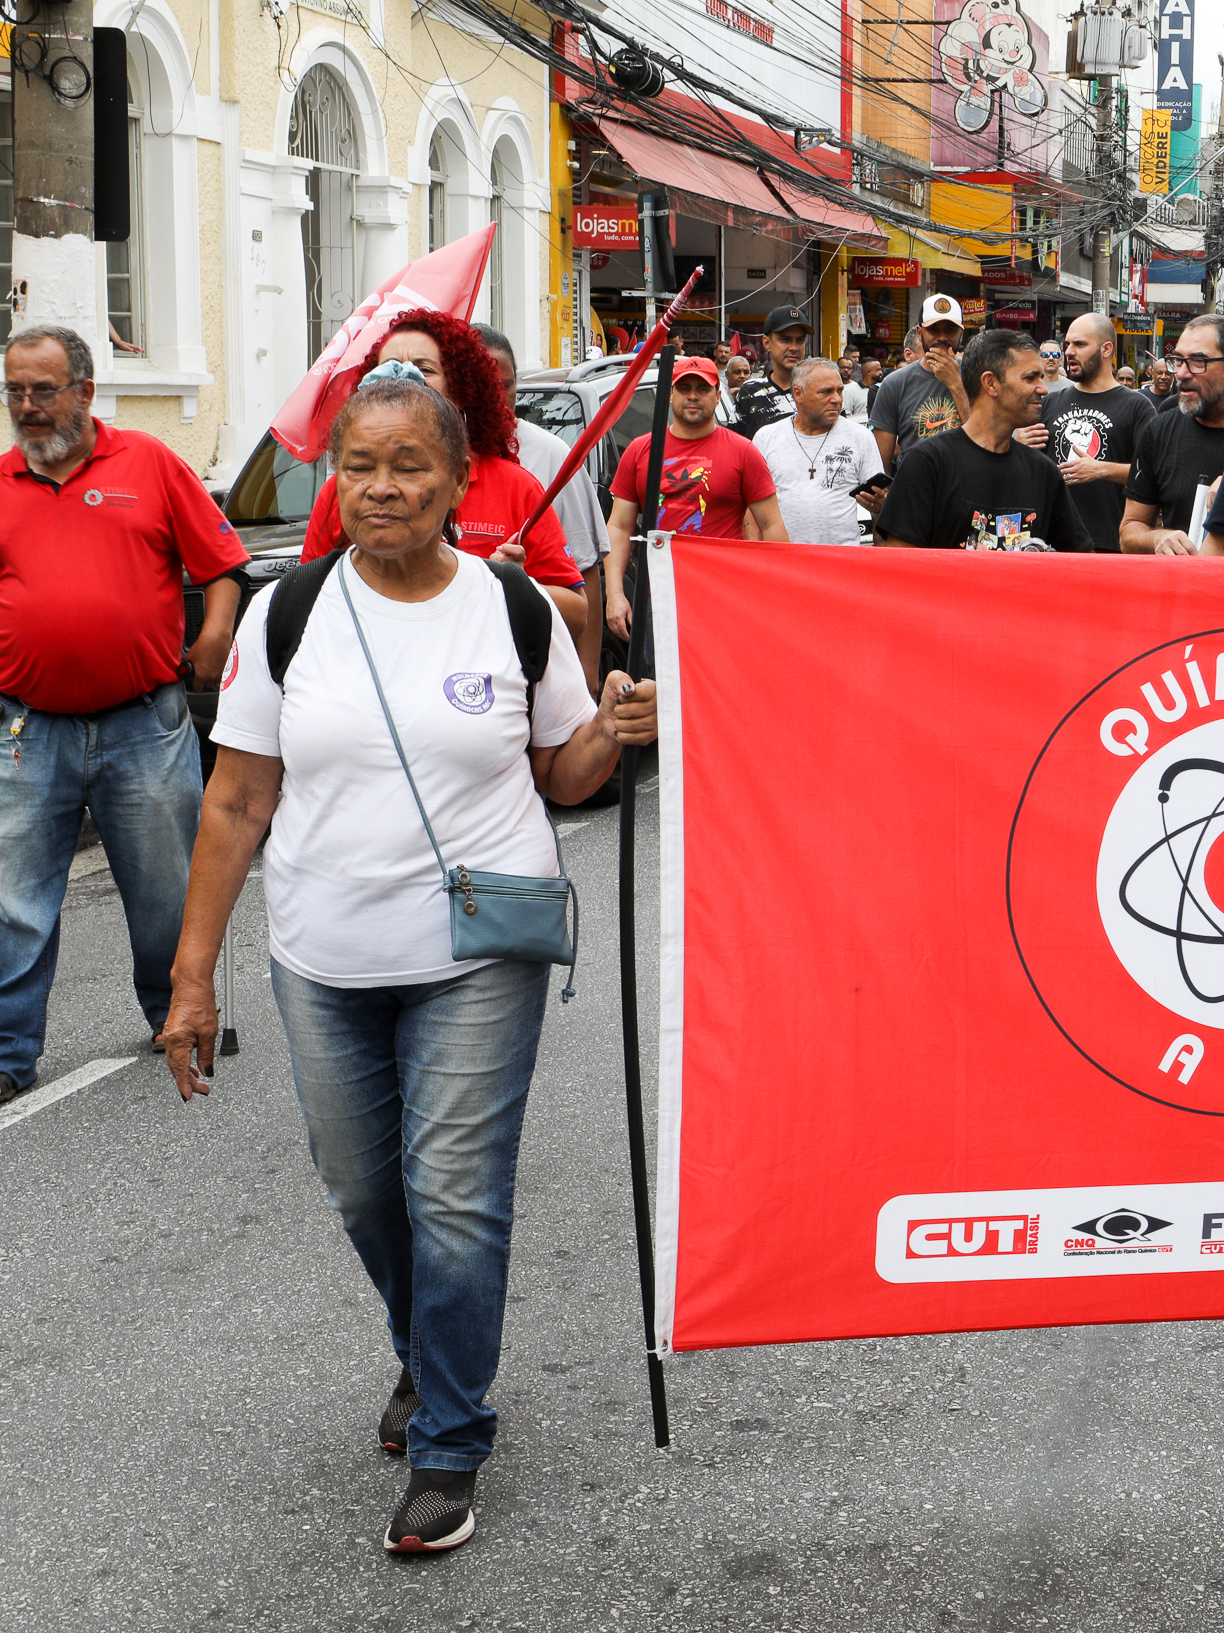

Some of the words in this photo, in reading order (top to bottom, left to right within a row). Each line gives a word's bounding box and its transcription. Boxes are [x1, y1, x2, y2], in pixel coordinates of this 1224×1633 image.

[577, 213, 639, 238] lojasm
[855, 261, 906, 279] lojasmel
[961, 300, 985, 310] Pastel
[1053, 408, 1113, 429] TRABALHADORES
[460, 521, 506, 534] STIMEIC
[908, 1219, 1025, 1254] CUT
[1027, 1214, 1040, 1254] BRASIL
[1064, 1239, 1096, 1249] CNQ
